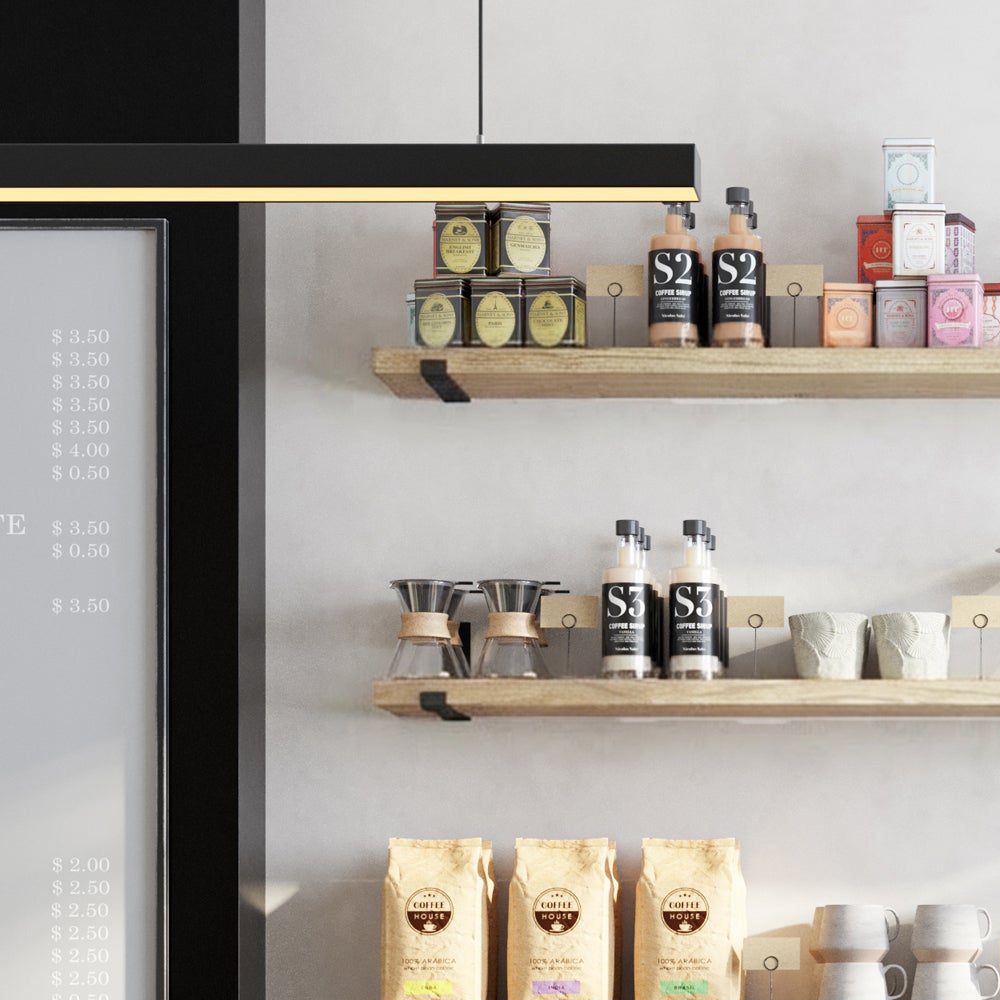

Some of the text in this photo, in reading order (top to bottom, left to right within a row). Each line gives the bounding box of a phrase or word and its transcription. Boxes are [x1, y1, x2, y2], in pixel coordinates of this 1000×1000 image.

[653, 252, 692, 285] S2
[718, 252, 756, 285] S2
[51, 328, 110, 345] $ 3.50
[51, 351, 110, 368] $ 3.50
[51, 374, 110, 391] $ 3.50
[51, 397, 110, 413] $ 3.50
[51, 419, 110, 436] $ 3.50
[51, 442, 110, 459] $ 4.00
[51, 464, 110, 481] $ 0.50
[51, 520, 110, 537] $ 3.50
[51, 542, 110, 559] $ 0.50
[51, 597, 110, 614] $ 3.50
[607, 585, 645, 618] S3
[674, 585, 713, 618] S3
[609, 622, 628, 630] COFFEE
[676, 622, 696, 630] COFFEE
[51, 857, 110, 873] $ 2.00
[51, 879, 110, 896] $ 2.50
[51, 902, 110, 919] $ 2.50
[51, 925, 110, 942] $ 2.50
[51, 947, 110, 964] $ 2.50
[51, 970, 110, 987] $ 2.50
